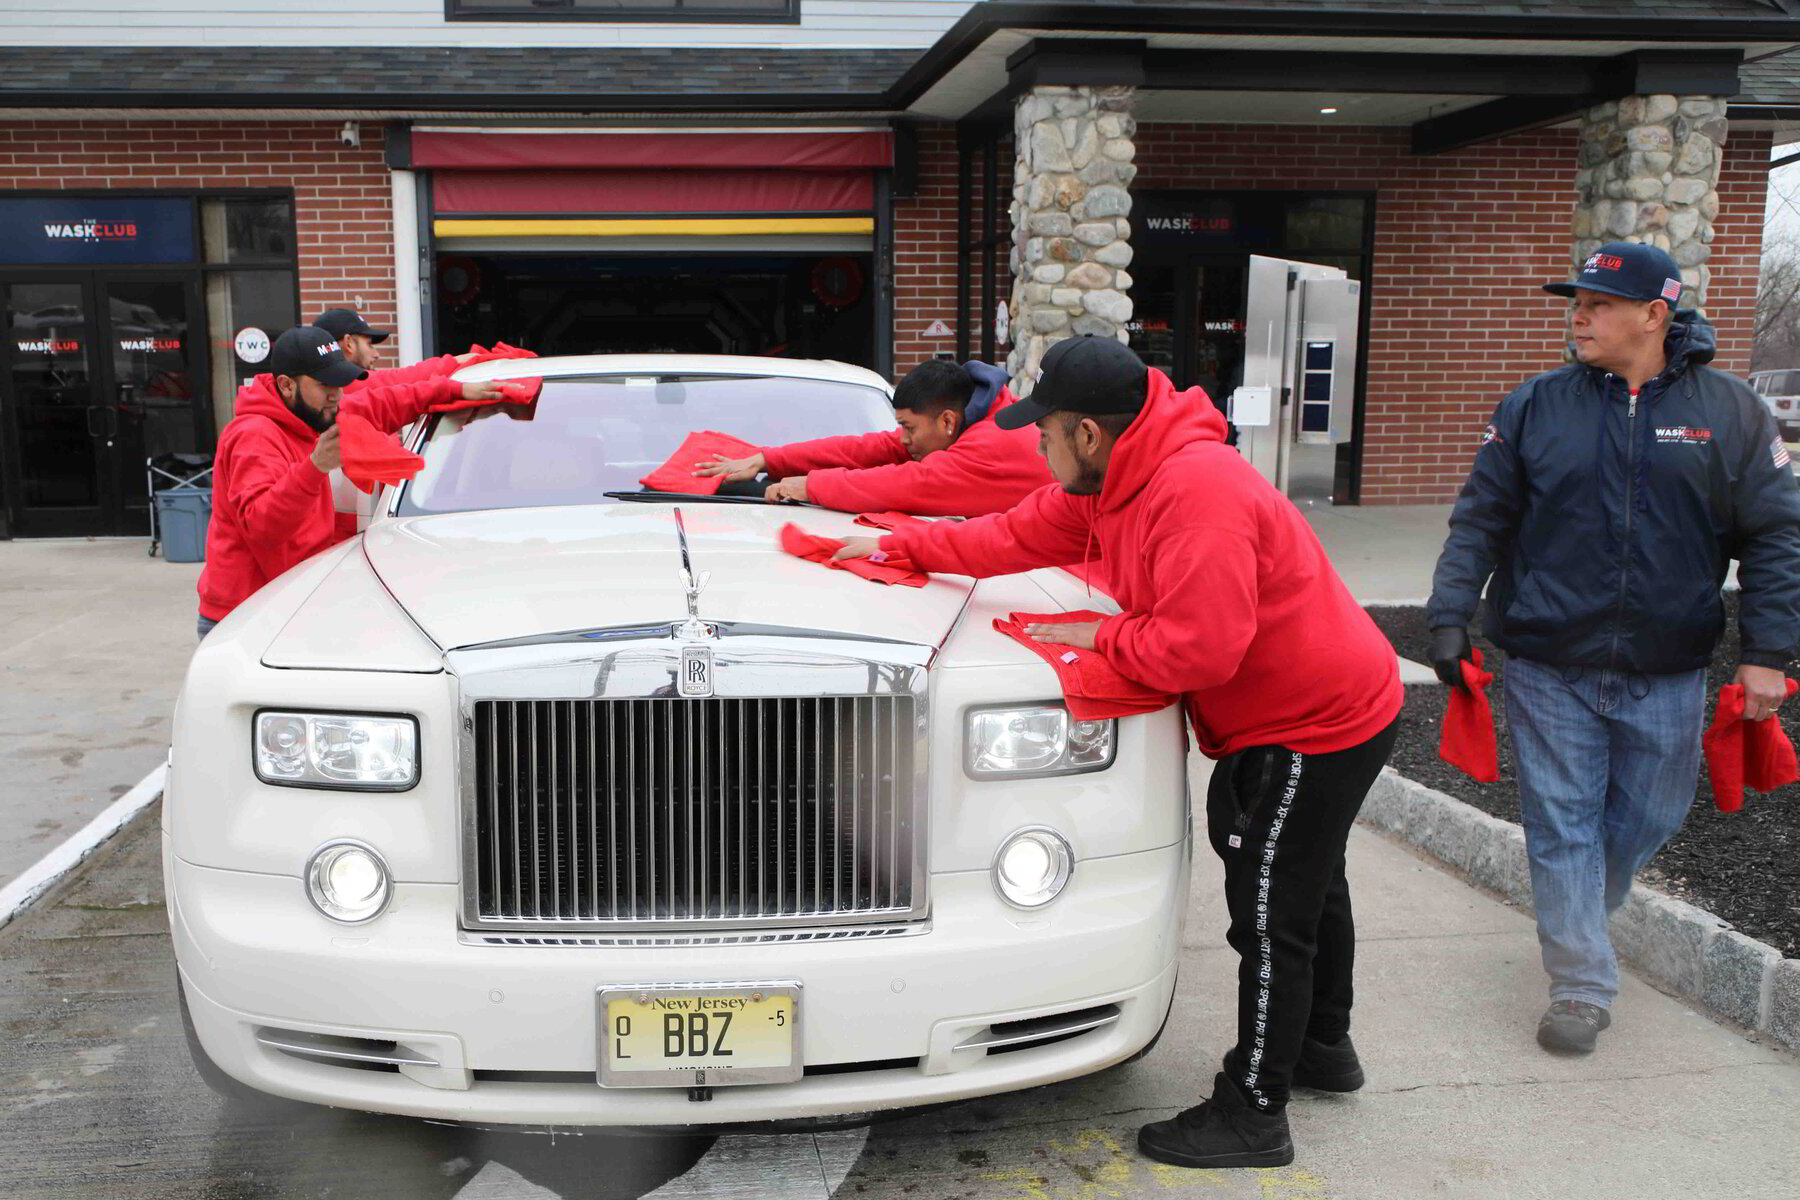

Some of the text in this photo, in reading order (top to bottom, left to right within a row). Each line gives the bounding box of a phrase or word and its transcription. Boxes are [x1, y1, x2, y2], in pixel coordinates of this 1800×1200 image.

[652, 997, 748, 1012] New Jersey
[664, 1012, 733, 1057] BBZ
